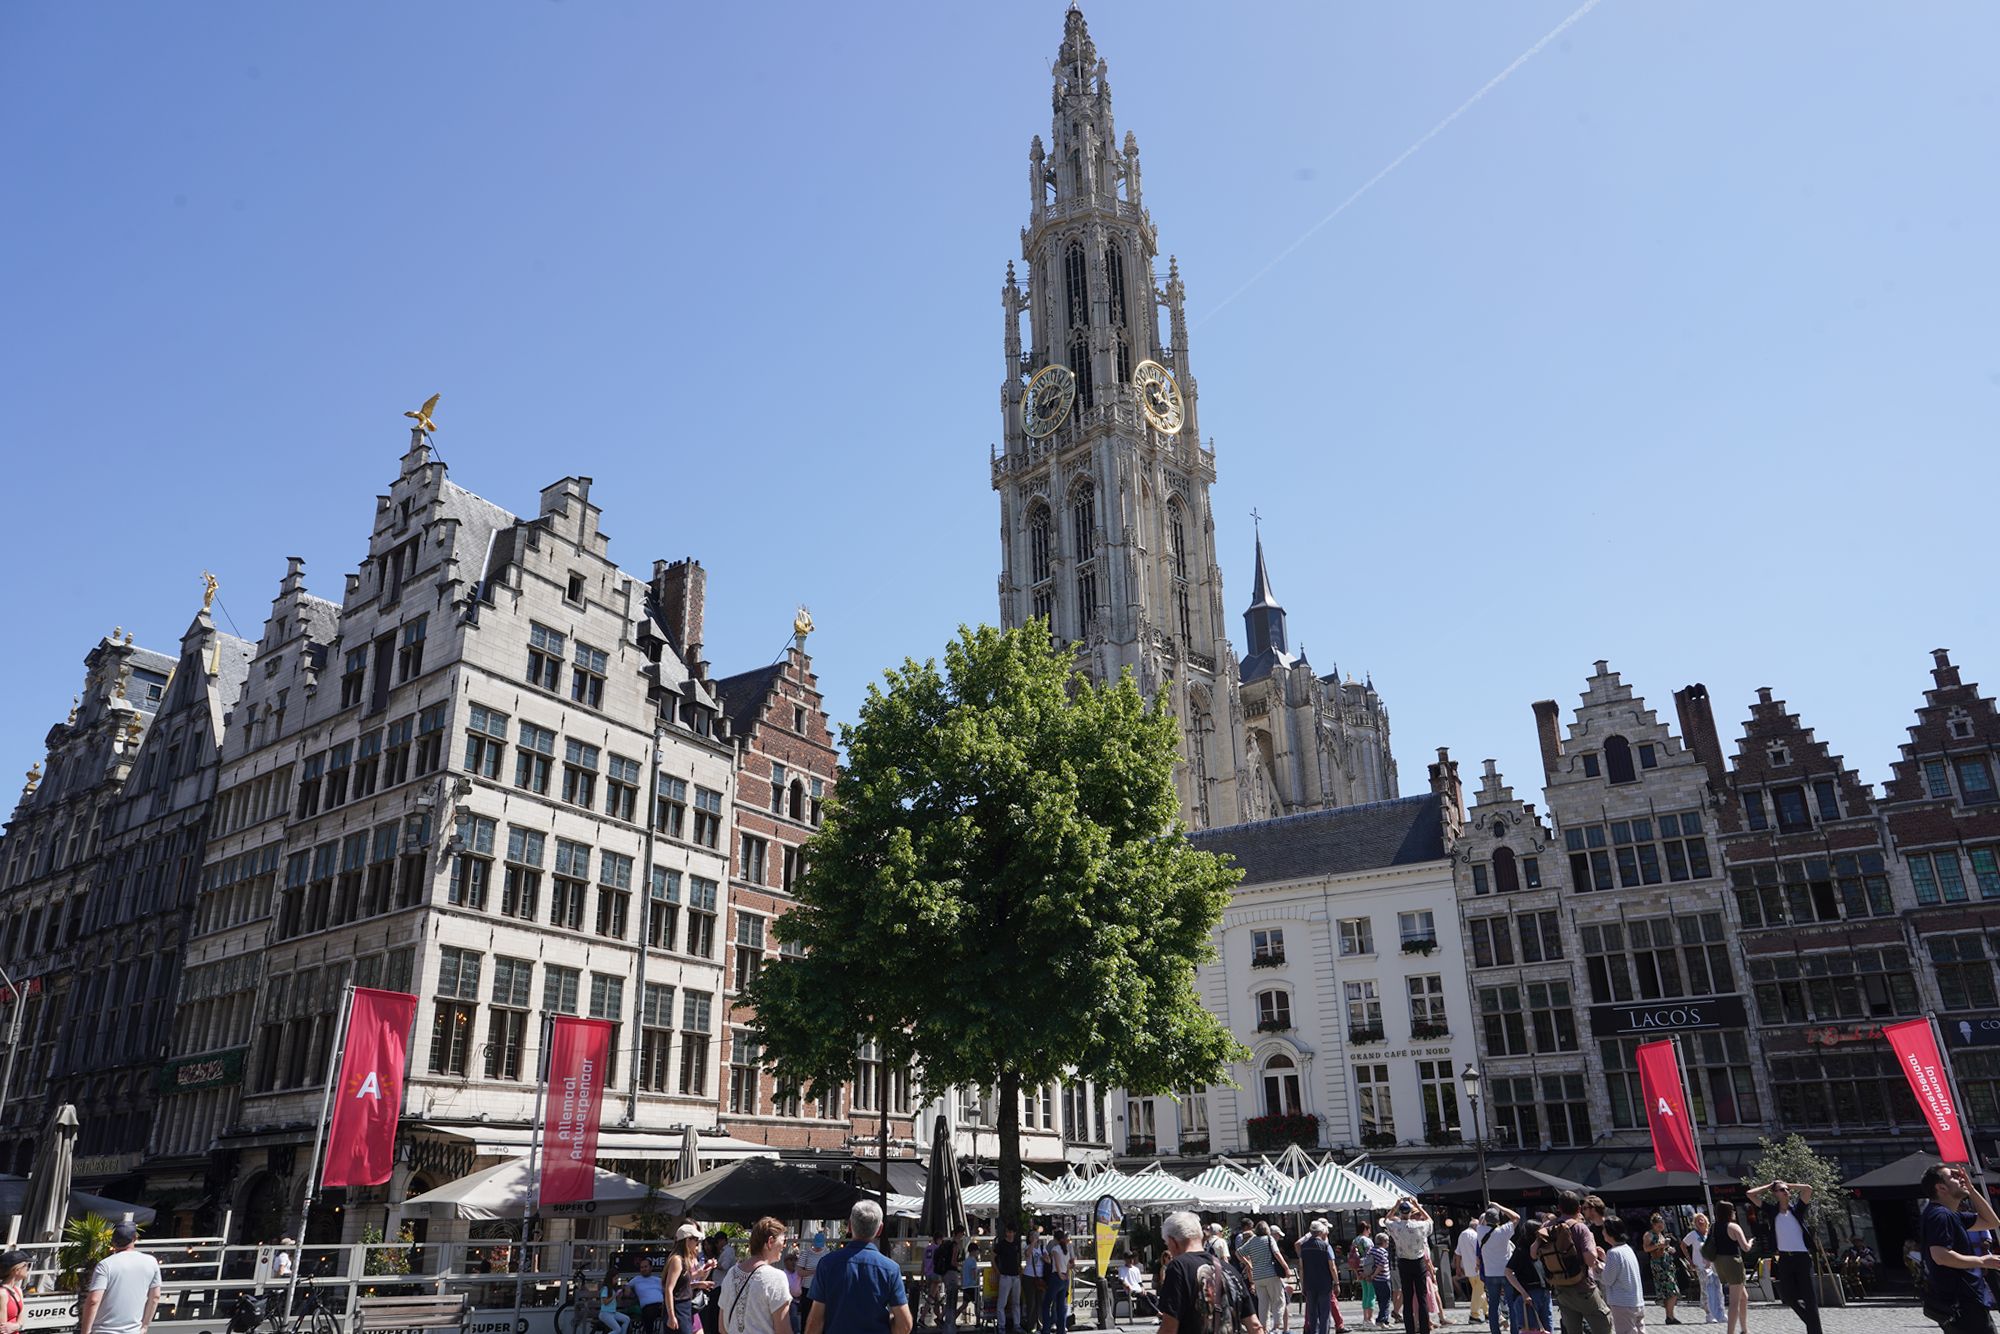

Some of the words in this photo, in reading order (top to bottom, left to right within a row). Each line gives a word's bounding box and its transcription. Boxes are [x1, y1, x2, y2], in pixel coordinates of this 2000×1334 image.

[1630, 1006, 1701, 1028] LACO'S
[1350, 1052, 1381, 1061] GRAND
[1426, 1047, 1450, 1055] NORD
[356, 1071, 382, 1099] A
[558, 1076, 577, 1140] Allemaal
[570, 1057, 593, 1160] Antwerpenaar
[1658, 1096, 1674, 1116] A
[28, 1308, 66, 1318] SUPER
